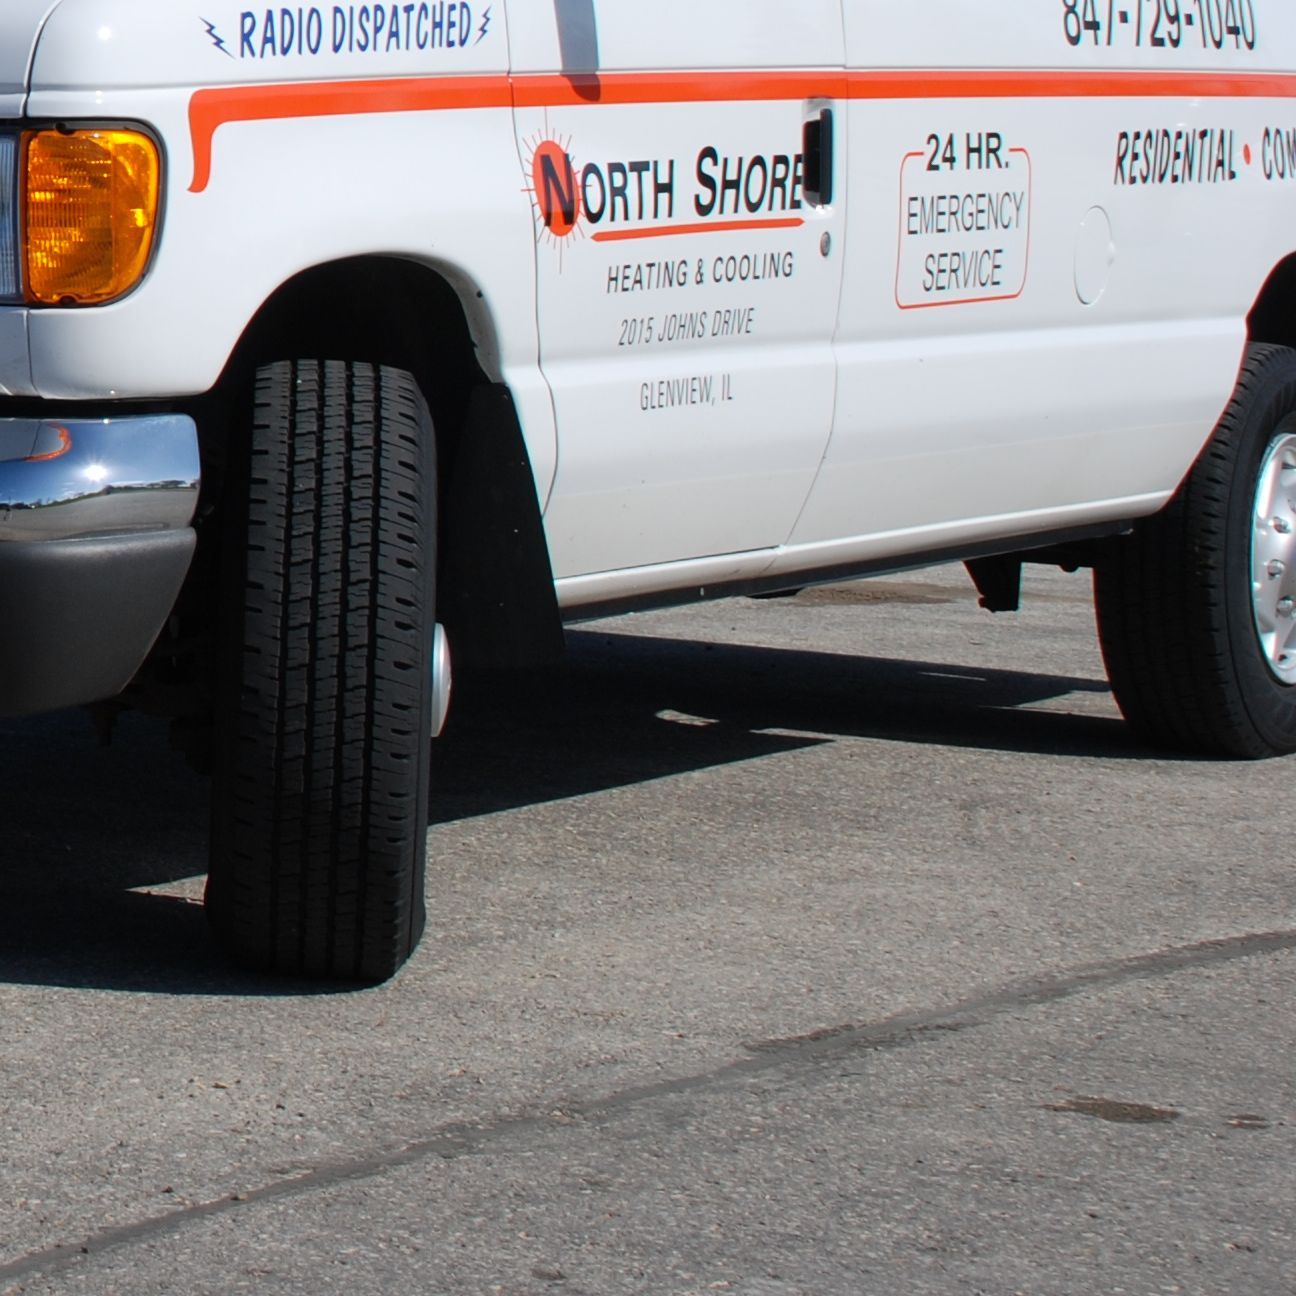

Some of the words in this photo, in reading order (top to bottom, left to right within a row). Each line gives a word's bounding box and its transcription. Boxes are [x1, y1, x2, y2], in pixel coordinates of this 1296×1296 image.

[240, 7, 322, 59] RADIO
[332, 0, 472, 54] DISPATCHED
[926, 132, 956, 171] 24
[965, 131, 1010, 169] HR.
[1114, 128, 1237, 185] RESIDENTIAL
[539, 153, 674, 227] NORTH
[694, 146, 803, 217] SHORE
[906, 191, 1024, 235] EMERGENCY
[607, 260, 687, 294] HEATING
[695, 259, 705, 285] &
[713, 251, 794, 284] COOLING
[923, 249, 1003, 292] SERVICE
[618, 317, 655, 346] 2015
[658, 311, 707, 343] JOHNS
[711, 307, 755, 337] DRIVE
[640, 375, 716, 411] GLENVIEW,
[722, 373, 734, 401] IL
